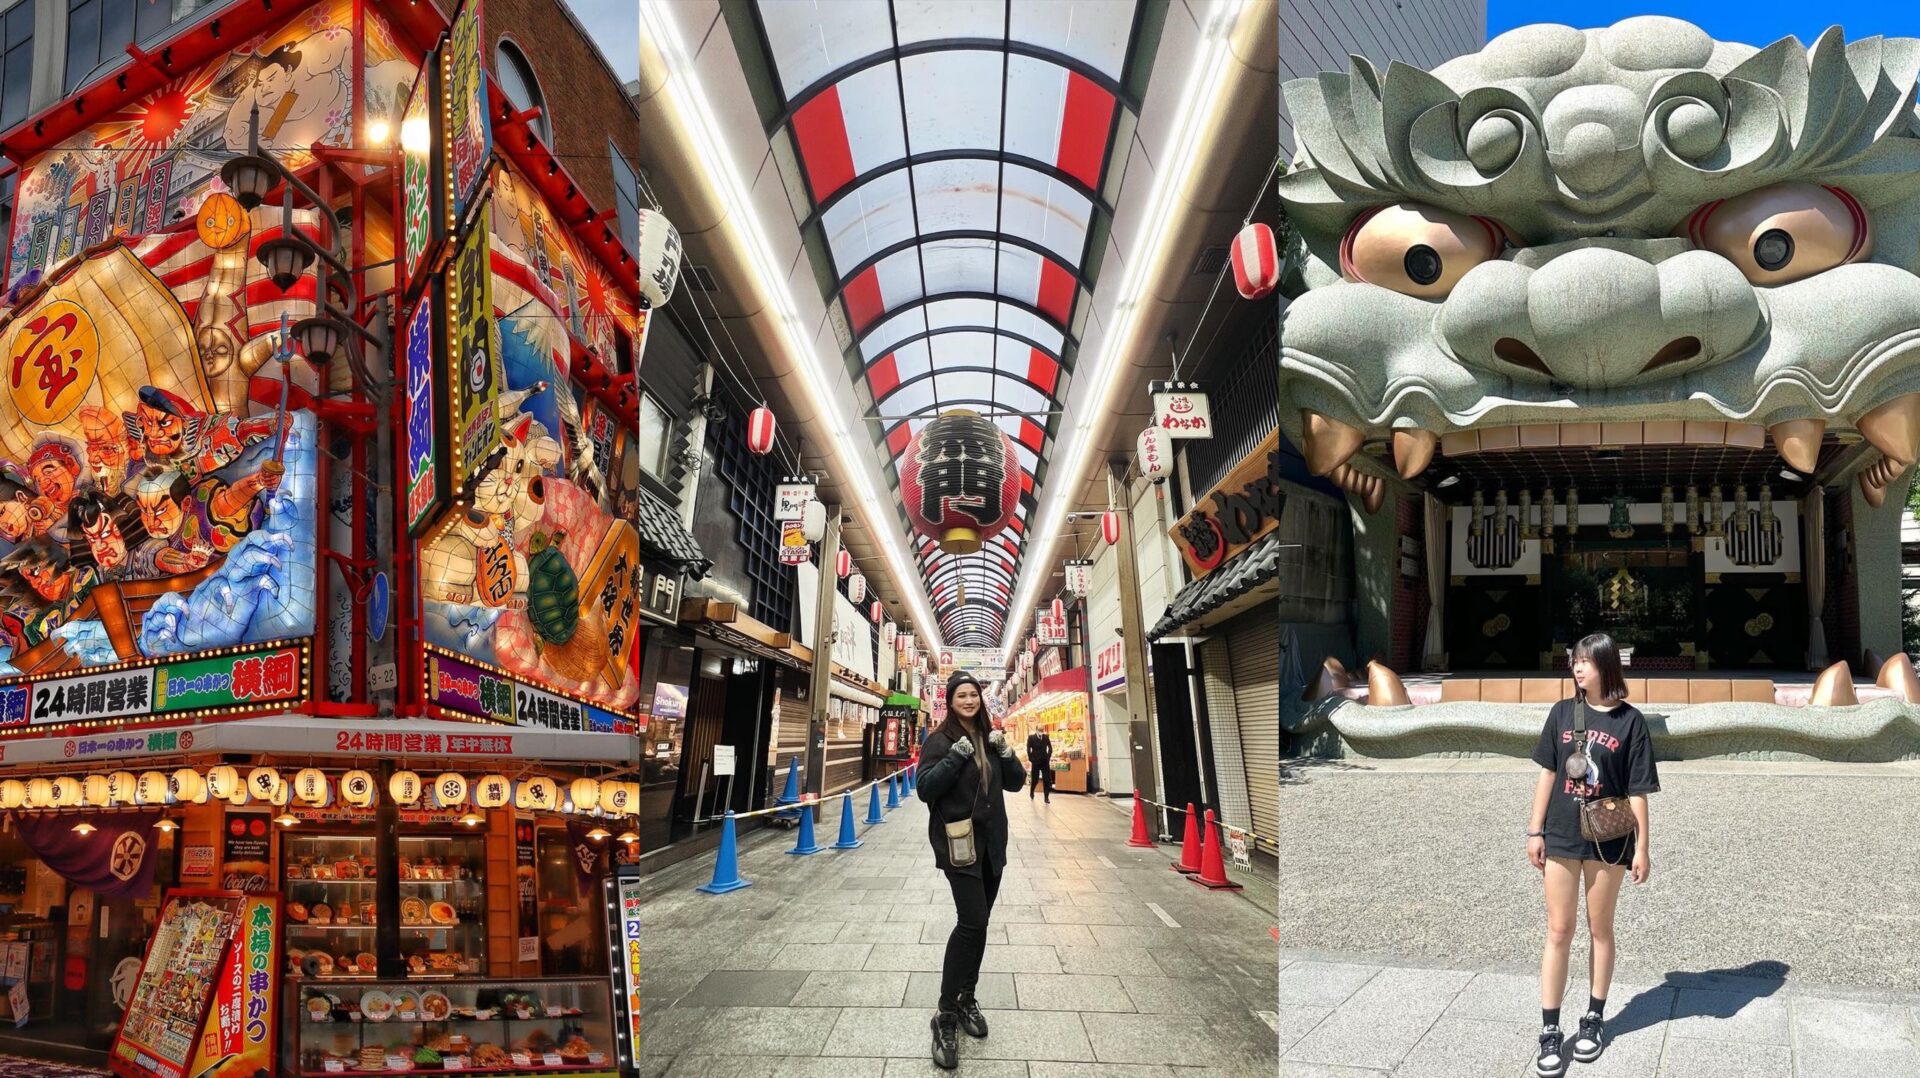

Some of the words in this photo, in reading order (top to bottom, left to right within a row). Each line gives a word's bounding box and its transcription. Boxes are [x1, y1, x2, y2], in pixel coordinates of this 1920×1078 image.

[1162, 413, 1206, 430] わなか
[1143, 429, 1161, 473] ほんまもん
[34, 675, 149, 719] 24時間営業
[167, 672, 230, 698] 日本一の串かつ
[230, 652, 296, 700] 横綱
[478, 675, 513, 718] 横綱
[517, 690, 581, 732] 24時間営業
[78, 737, 144, 755] 日本一の串かつ
[147, 730, 178, 752] 横綱
[336, 730, 443, 752] 24時間営業
[449, 737, 508, 752] 年中無休
[1562, 729, 1620, 753] SPER
[246, 903, 273, 1043] 本場の串かつ
